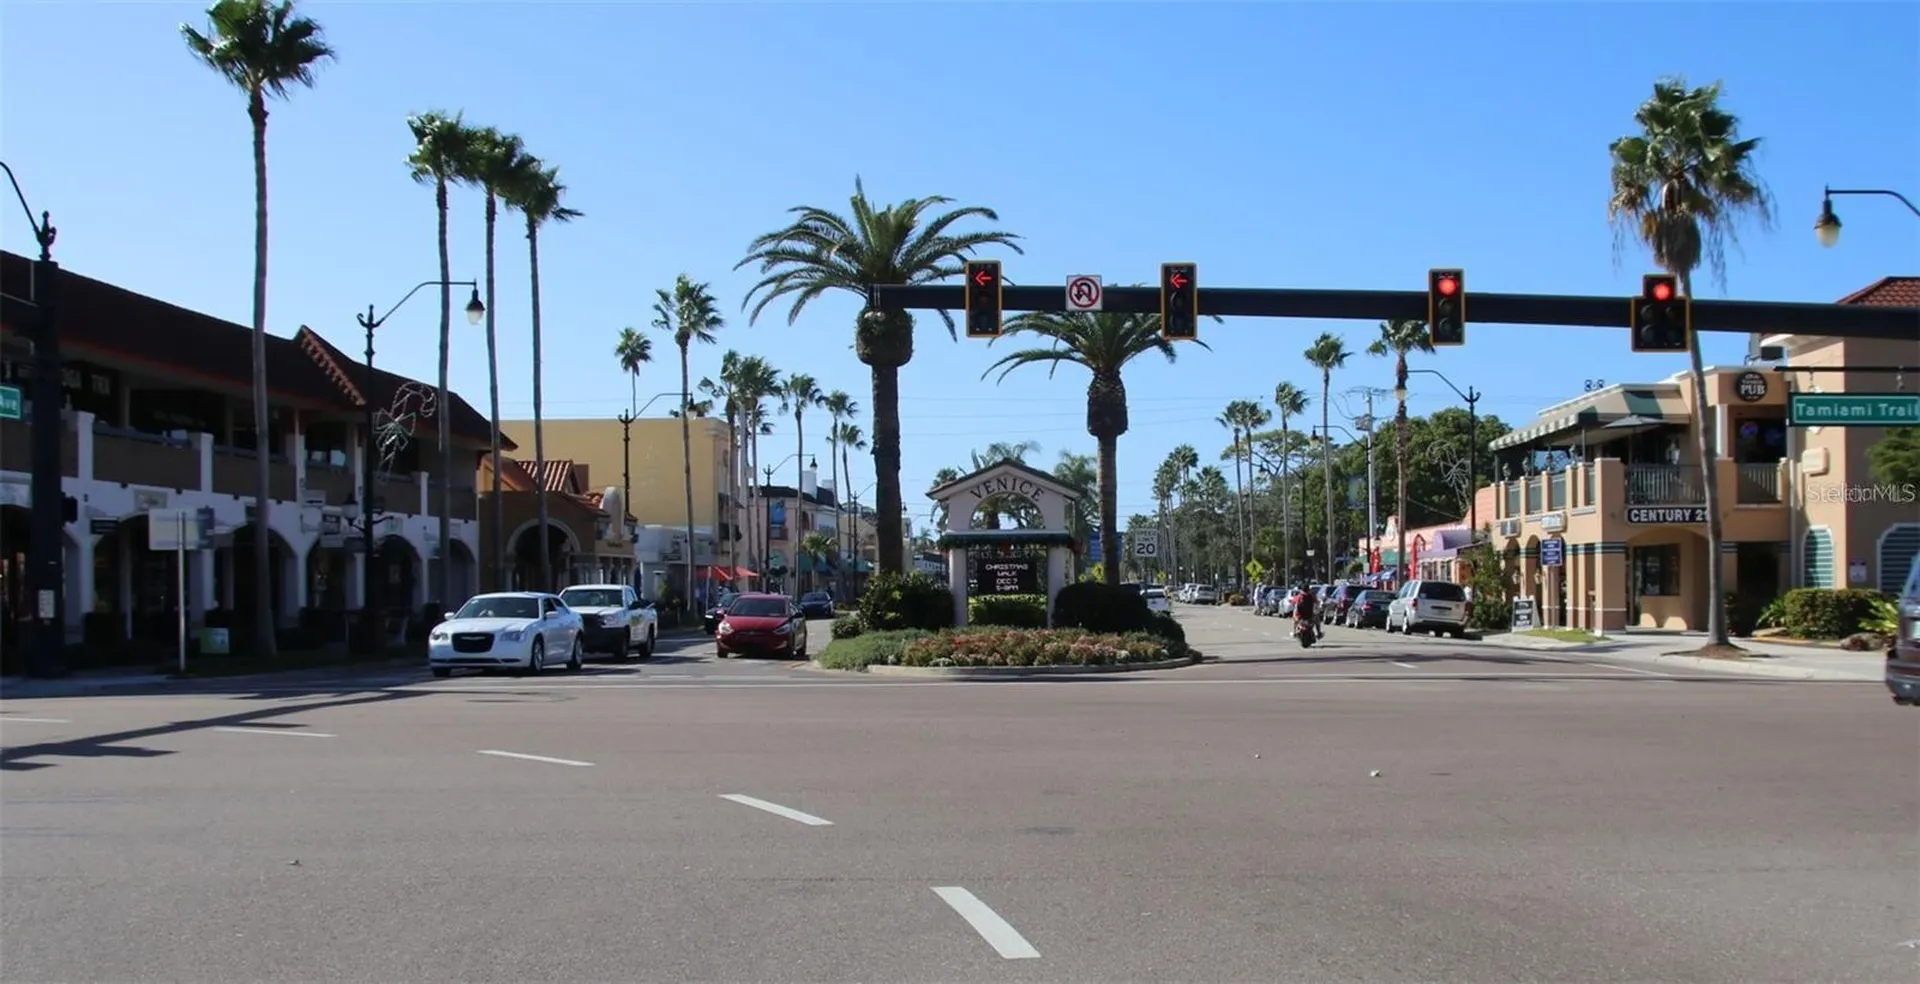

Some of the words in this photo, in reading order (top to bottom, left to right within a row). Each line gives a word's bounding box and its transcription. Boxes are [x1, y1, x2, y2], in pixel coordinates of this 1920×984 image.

[1741, 384, 1765, 395] PUB
[1796, 403, 1872, 416] Tamiami
[1878, 403, 1919, 416] Trail
[970, 478, 1044, 501] VENICE
[1631, 509, 1691, 522] CENTURY
[1136, 543, 1155, 554] 20
[996, 577, 1011, 585] DEC
